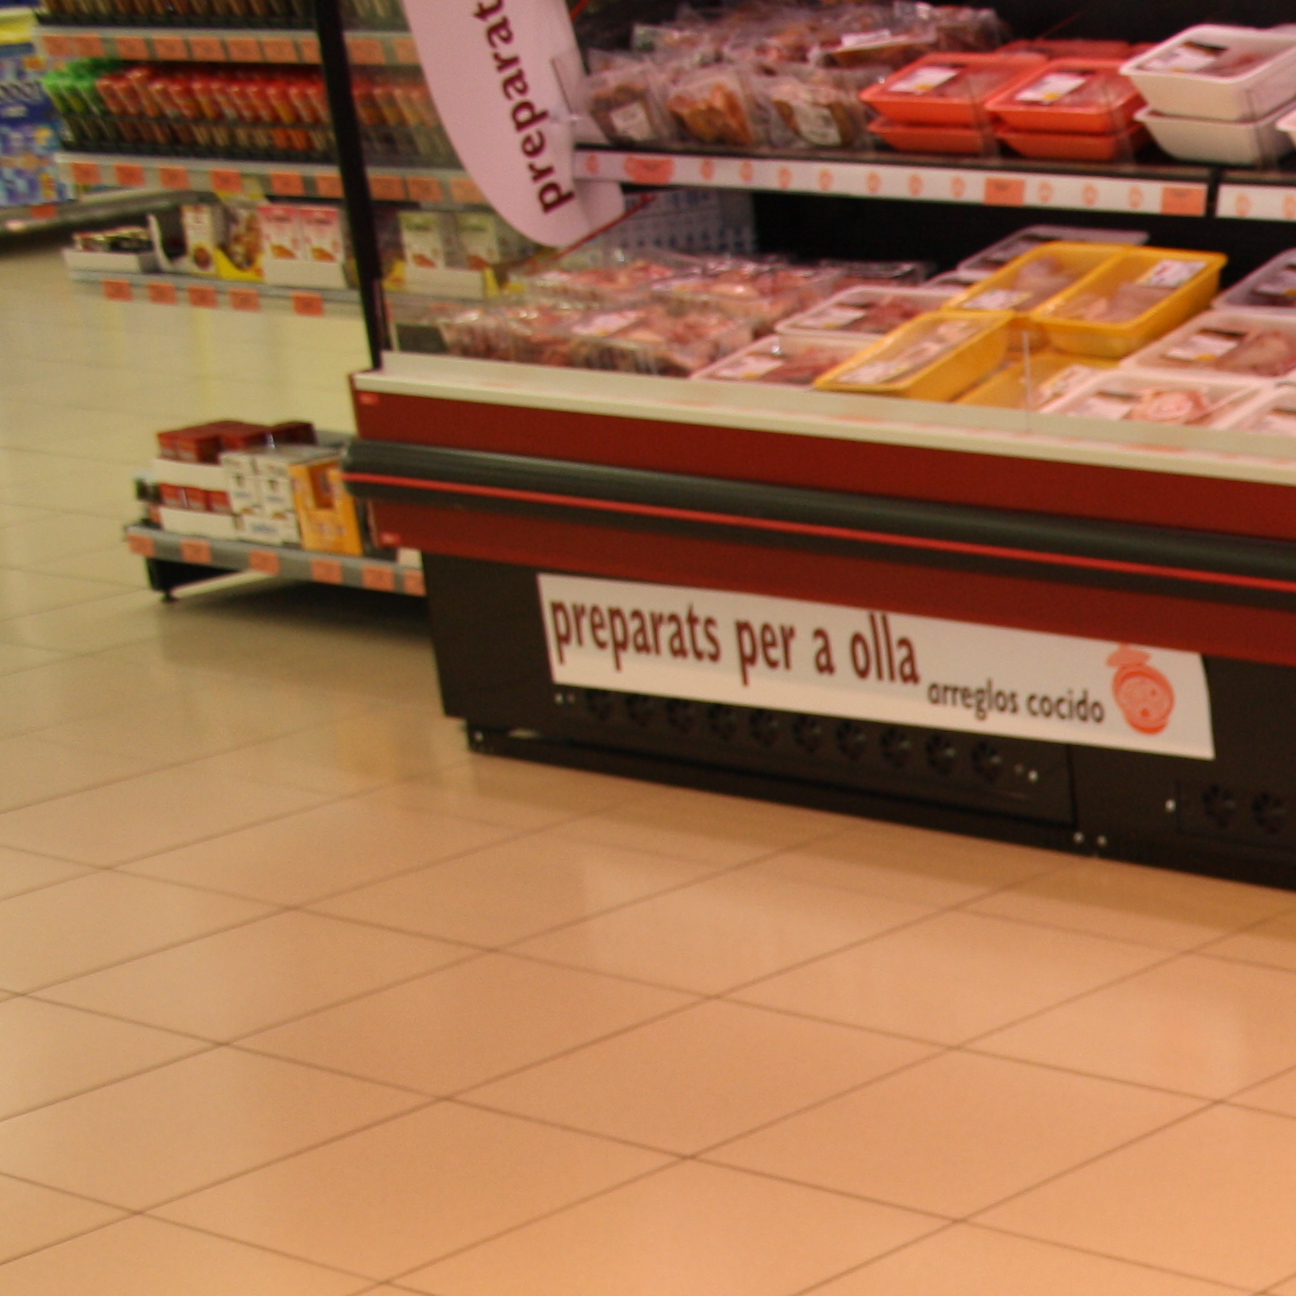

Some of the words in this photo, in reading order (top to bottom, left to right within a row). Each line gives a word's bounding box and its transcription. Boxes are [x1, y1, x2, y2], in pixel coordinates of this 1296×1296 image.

[551, 600, 721, 672] preparats
[735, 618, 796, 686] per
[813, 626, 835, 676] a
[851, 611, 920, 686] olla
[927, 678, 1019, 721] arreglos
[1027, 688, 1105, 724] cocido
